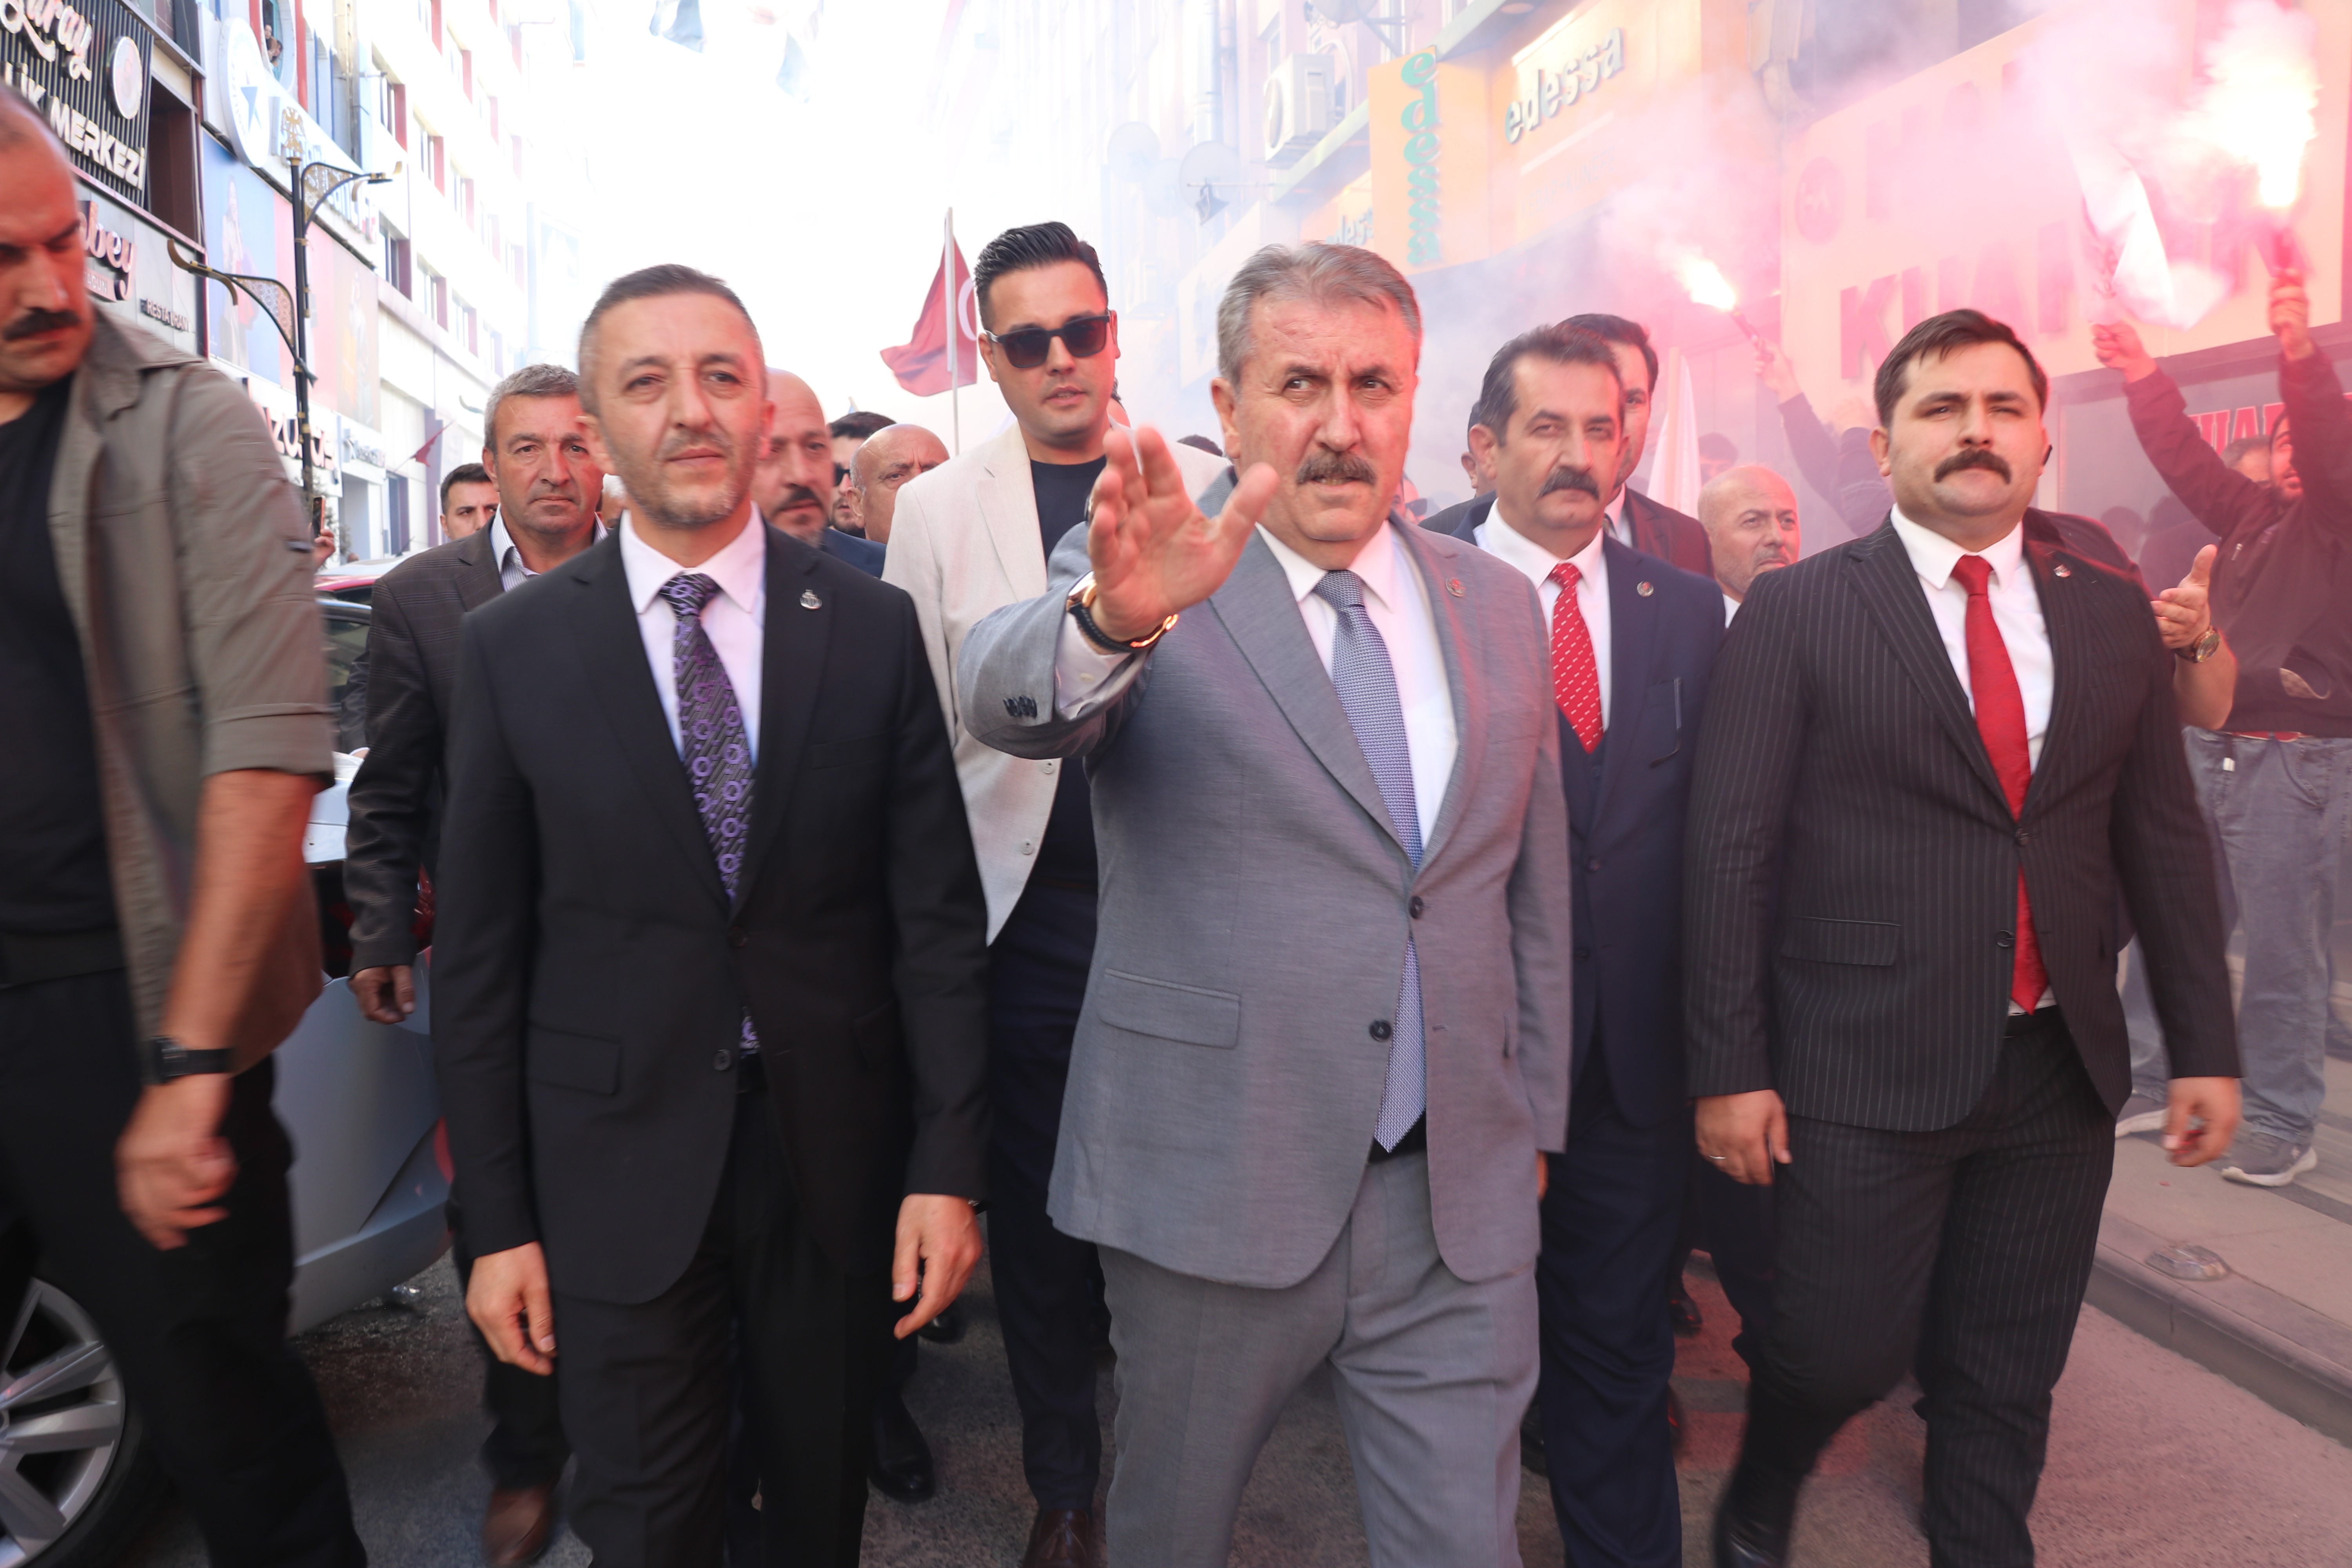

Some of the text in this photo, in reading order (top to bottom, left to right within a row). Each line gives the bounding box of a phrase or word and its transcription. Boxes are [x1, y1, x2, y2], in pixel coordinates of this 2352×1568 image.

[50, 96, 145, 191] MERKEZİ
[1504, 27, 1624, 145] edessa
[1401, 52, 1441, 265] edessa
